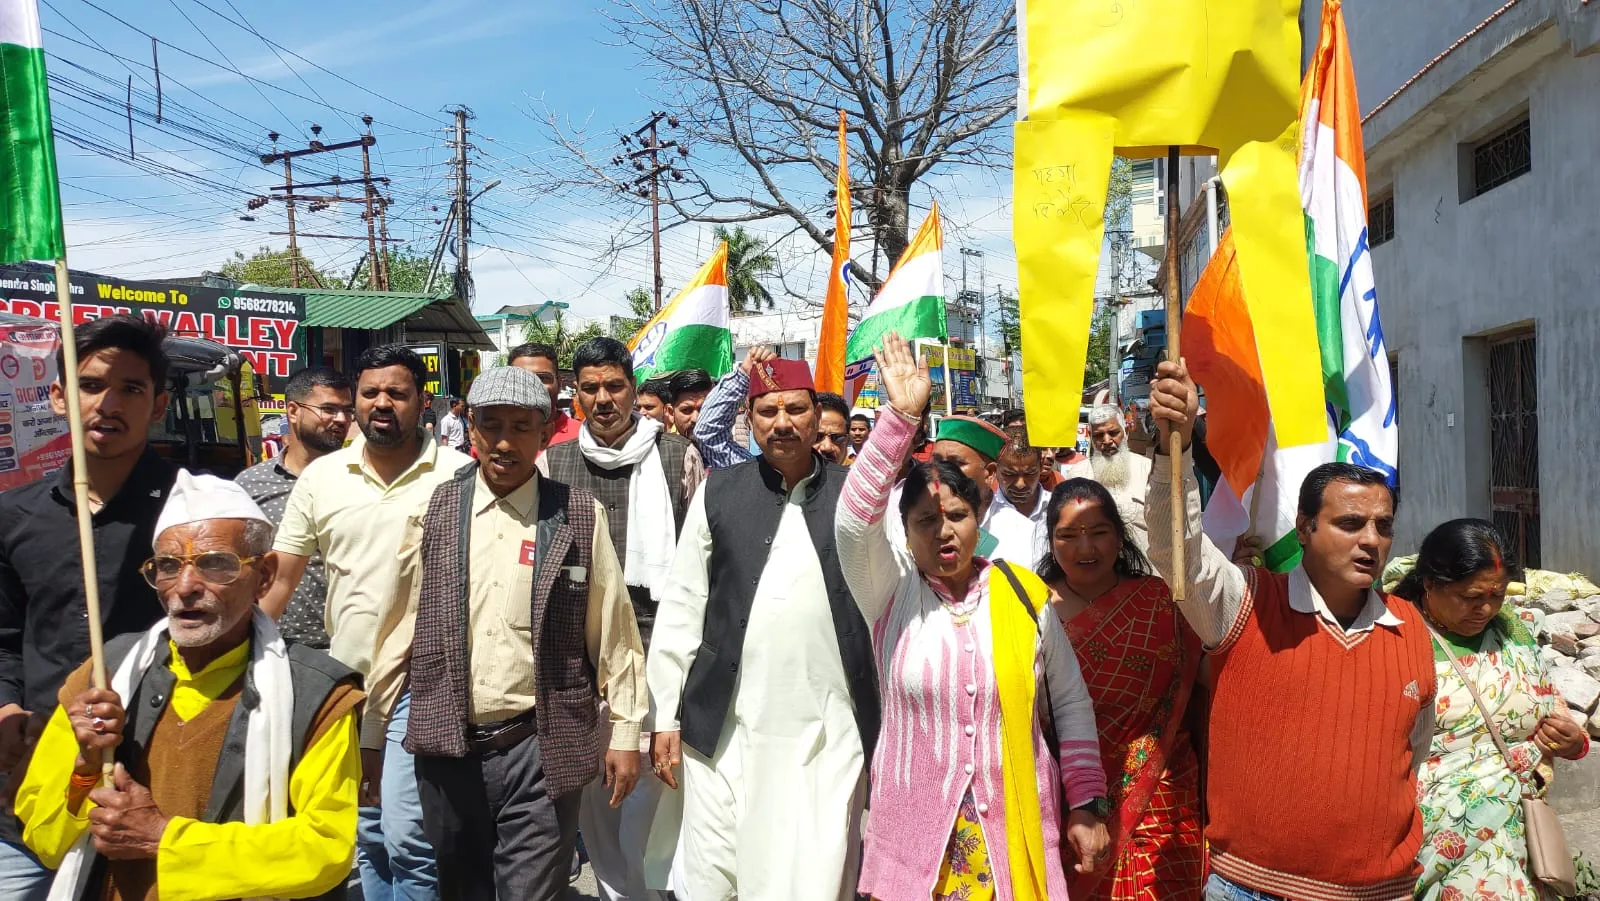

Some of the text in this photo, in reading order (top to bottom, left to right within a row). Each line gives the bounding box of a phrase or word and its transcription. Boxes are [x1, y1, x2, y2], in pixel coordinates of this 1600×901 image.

[0, 278, 29, 290] endra
[30, 279, 56, 295] Singh
[97, 284, 296, 314] Welcome To 9568278214
